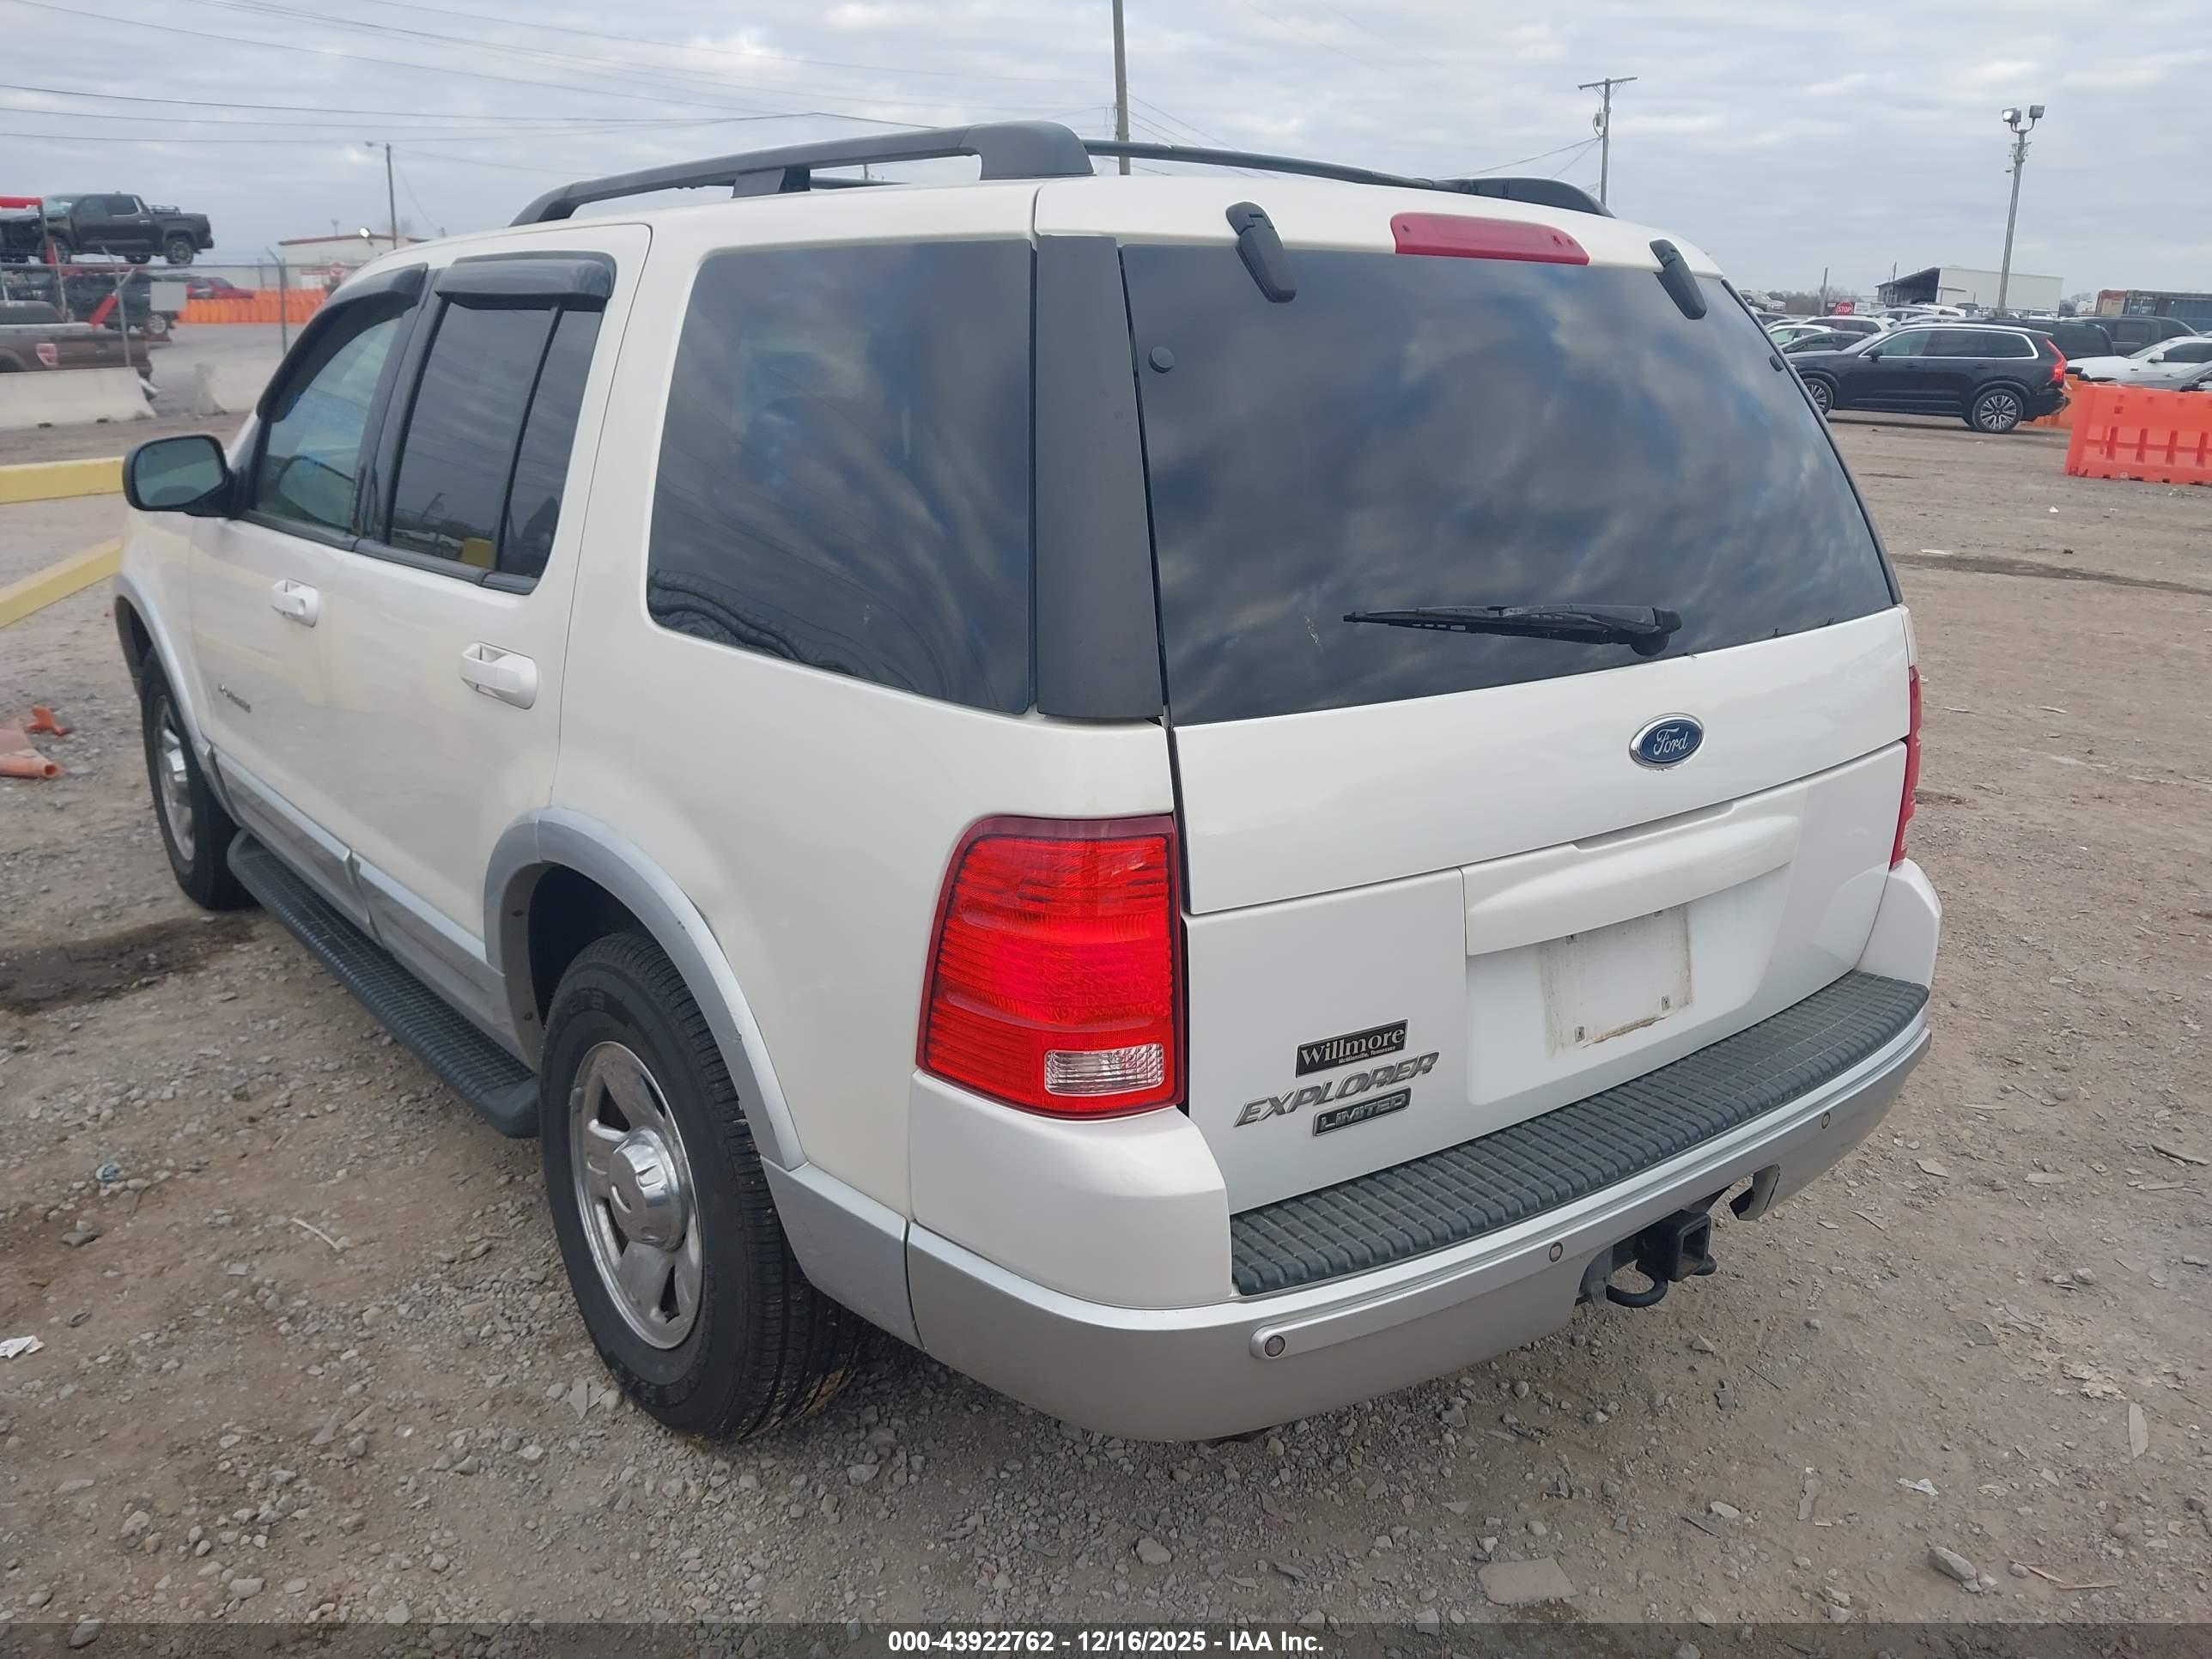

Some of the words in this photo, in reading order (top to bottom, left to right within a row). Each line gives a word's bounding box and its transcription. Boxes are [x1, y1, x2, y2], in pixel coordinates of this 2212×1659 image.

[1653, 727, 1689, 756] Ford
[1300, 1027, 1405, 1066] Willmore
[1233, 1051, 1440, 1127] EXPLORER
[1320, 1092, 1407, 1131] LIMITED
